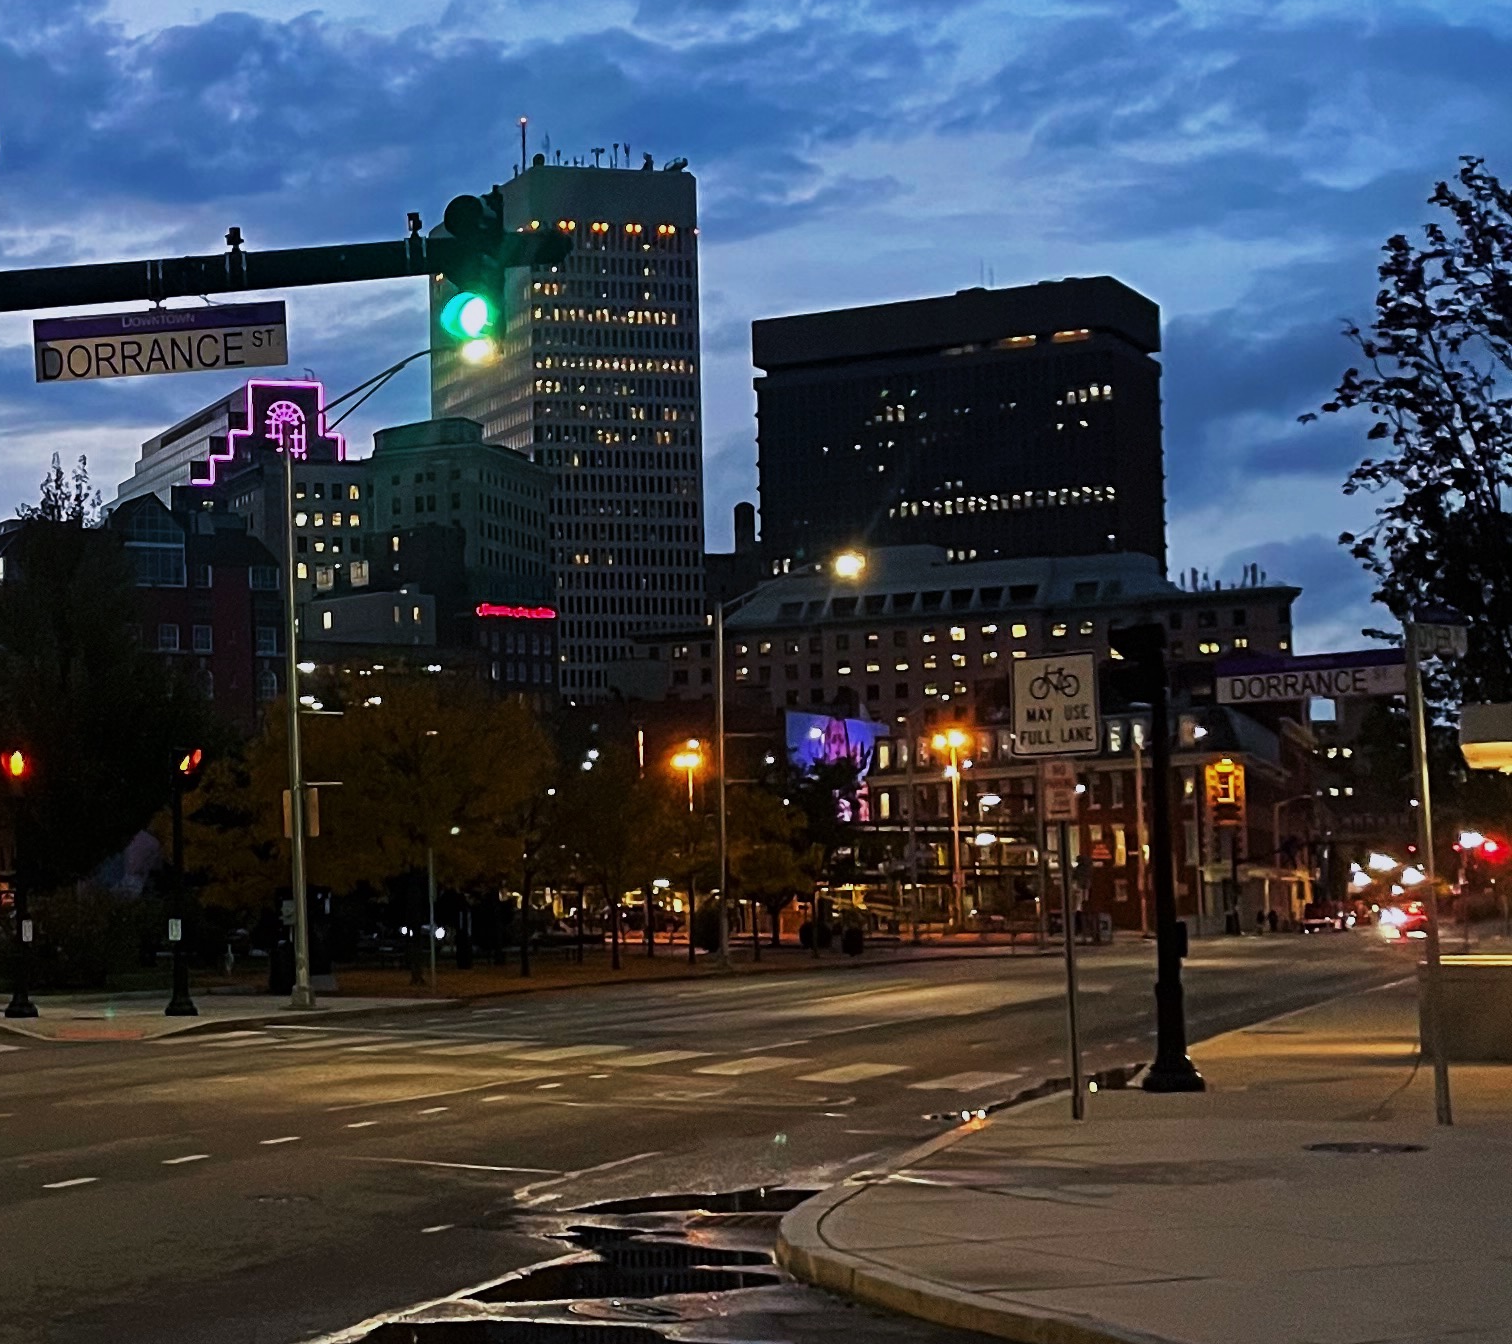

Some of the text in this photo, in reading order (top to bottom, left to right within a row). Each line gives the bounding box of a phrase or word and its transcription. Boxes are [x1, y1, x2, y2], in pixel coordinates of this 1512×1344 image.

[41, 332, 245, 380] DORRANCE
[1231, 669, 1368, 700] DORRANCE
[1026, 704, 1090, 722] MAY USE
[1020, 727, 1093, 746] FULL LANE
